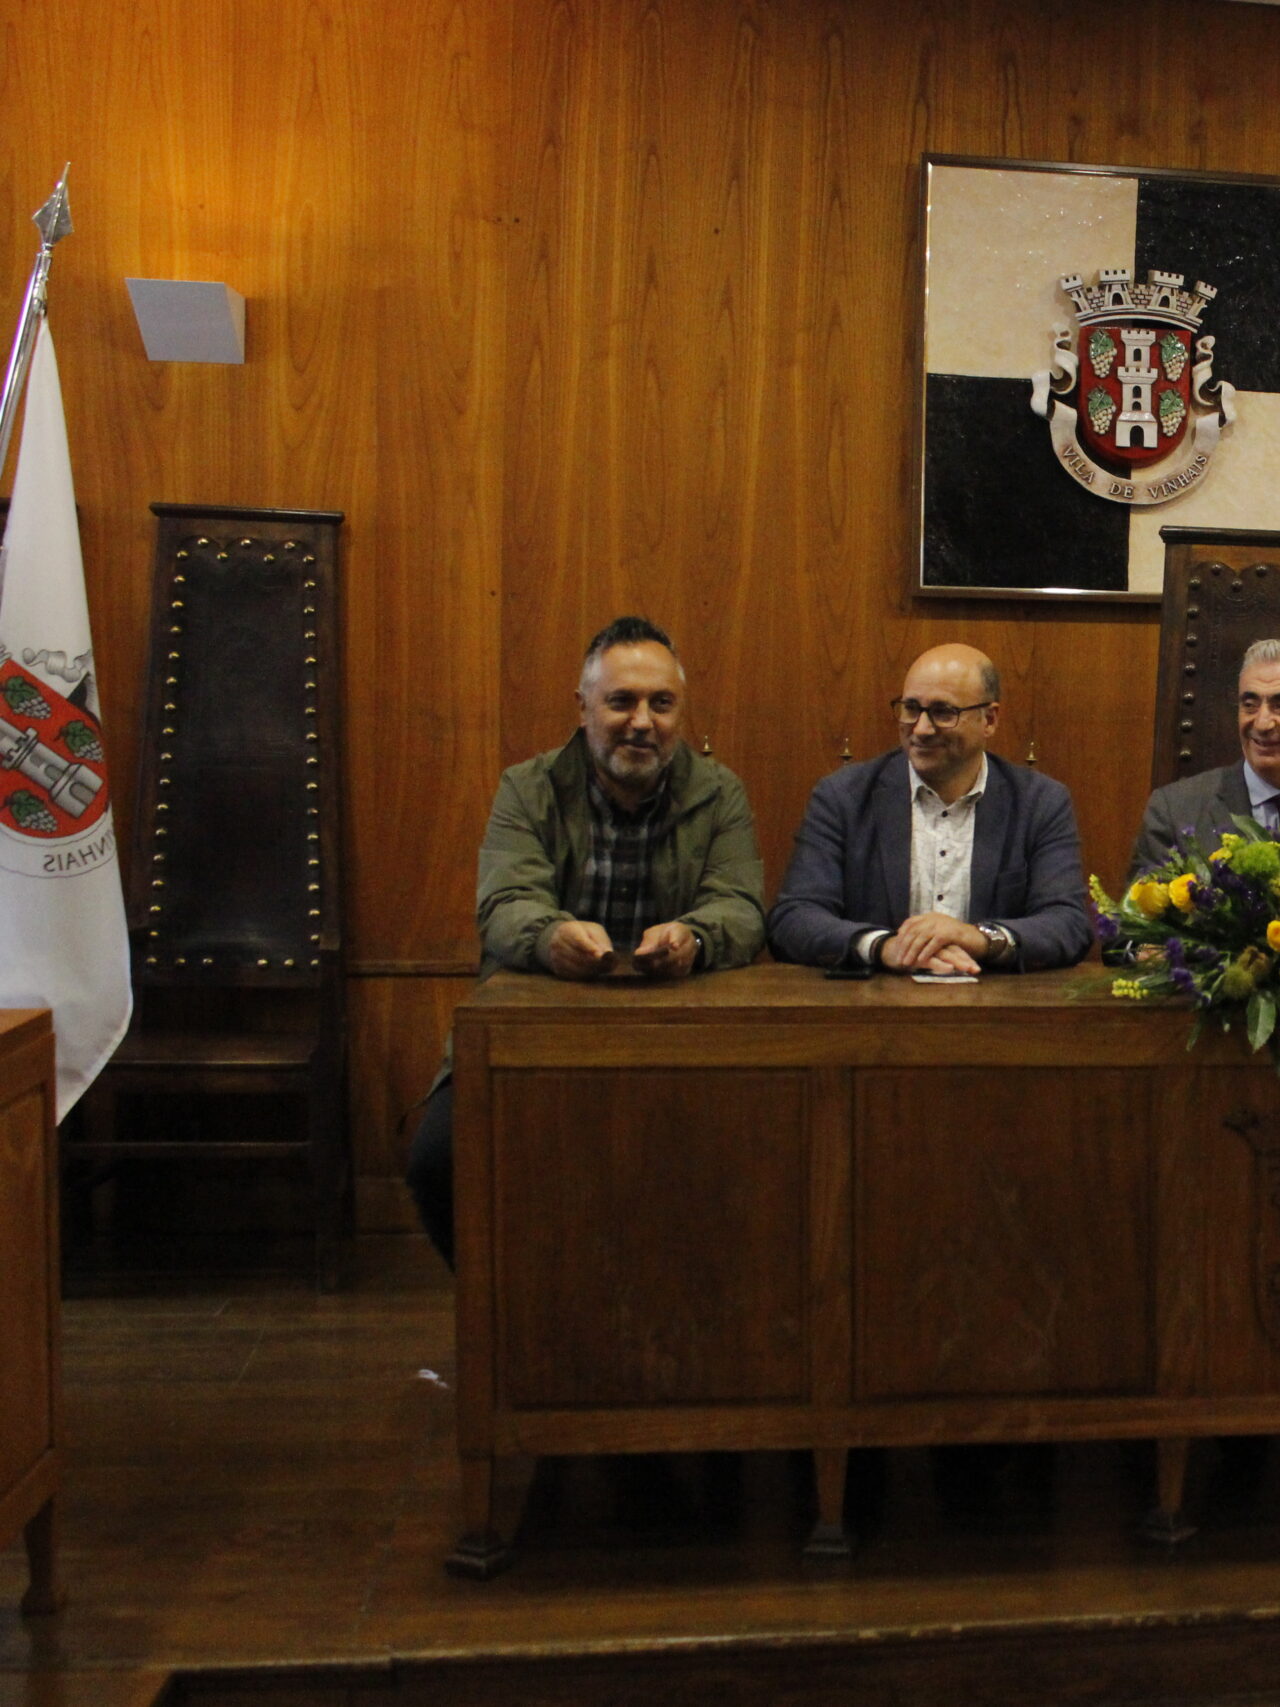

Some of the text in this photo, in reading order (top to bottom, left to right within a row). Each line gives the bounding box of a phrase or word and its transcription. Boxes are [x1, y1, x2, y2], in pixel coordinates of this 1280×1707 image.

[1063, 447, 1208, 499] VILA DE VINHAIS
